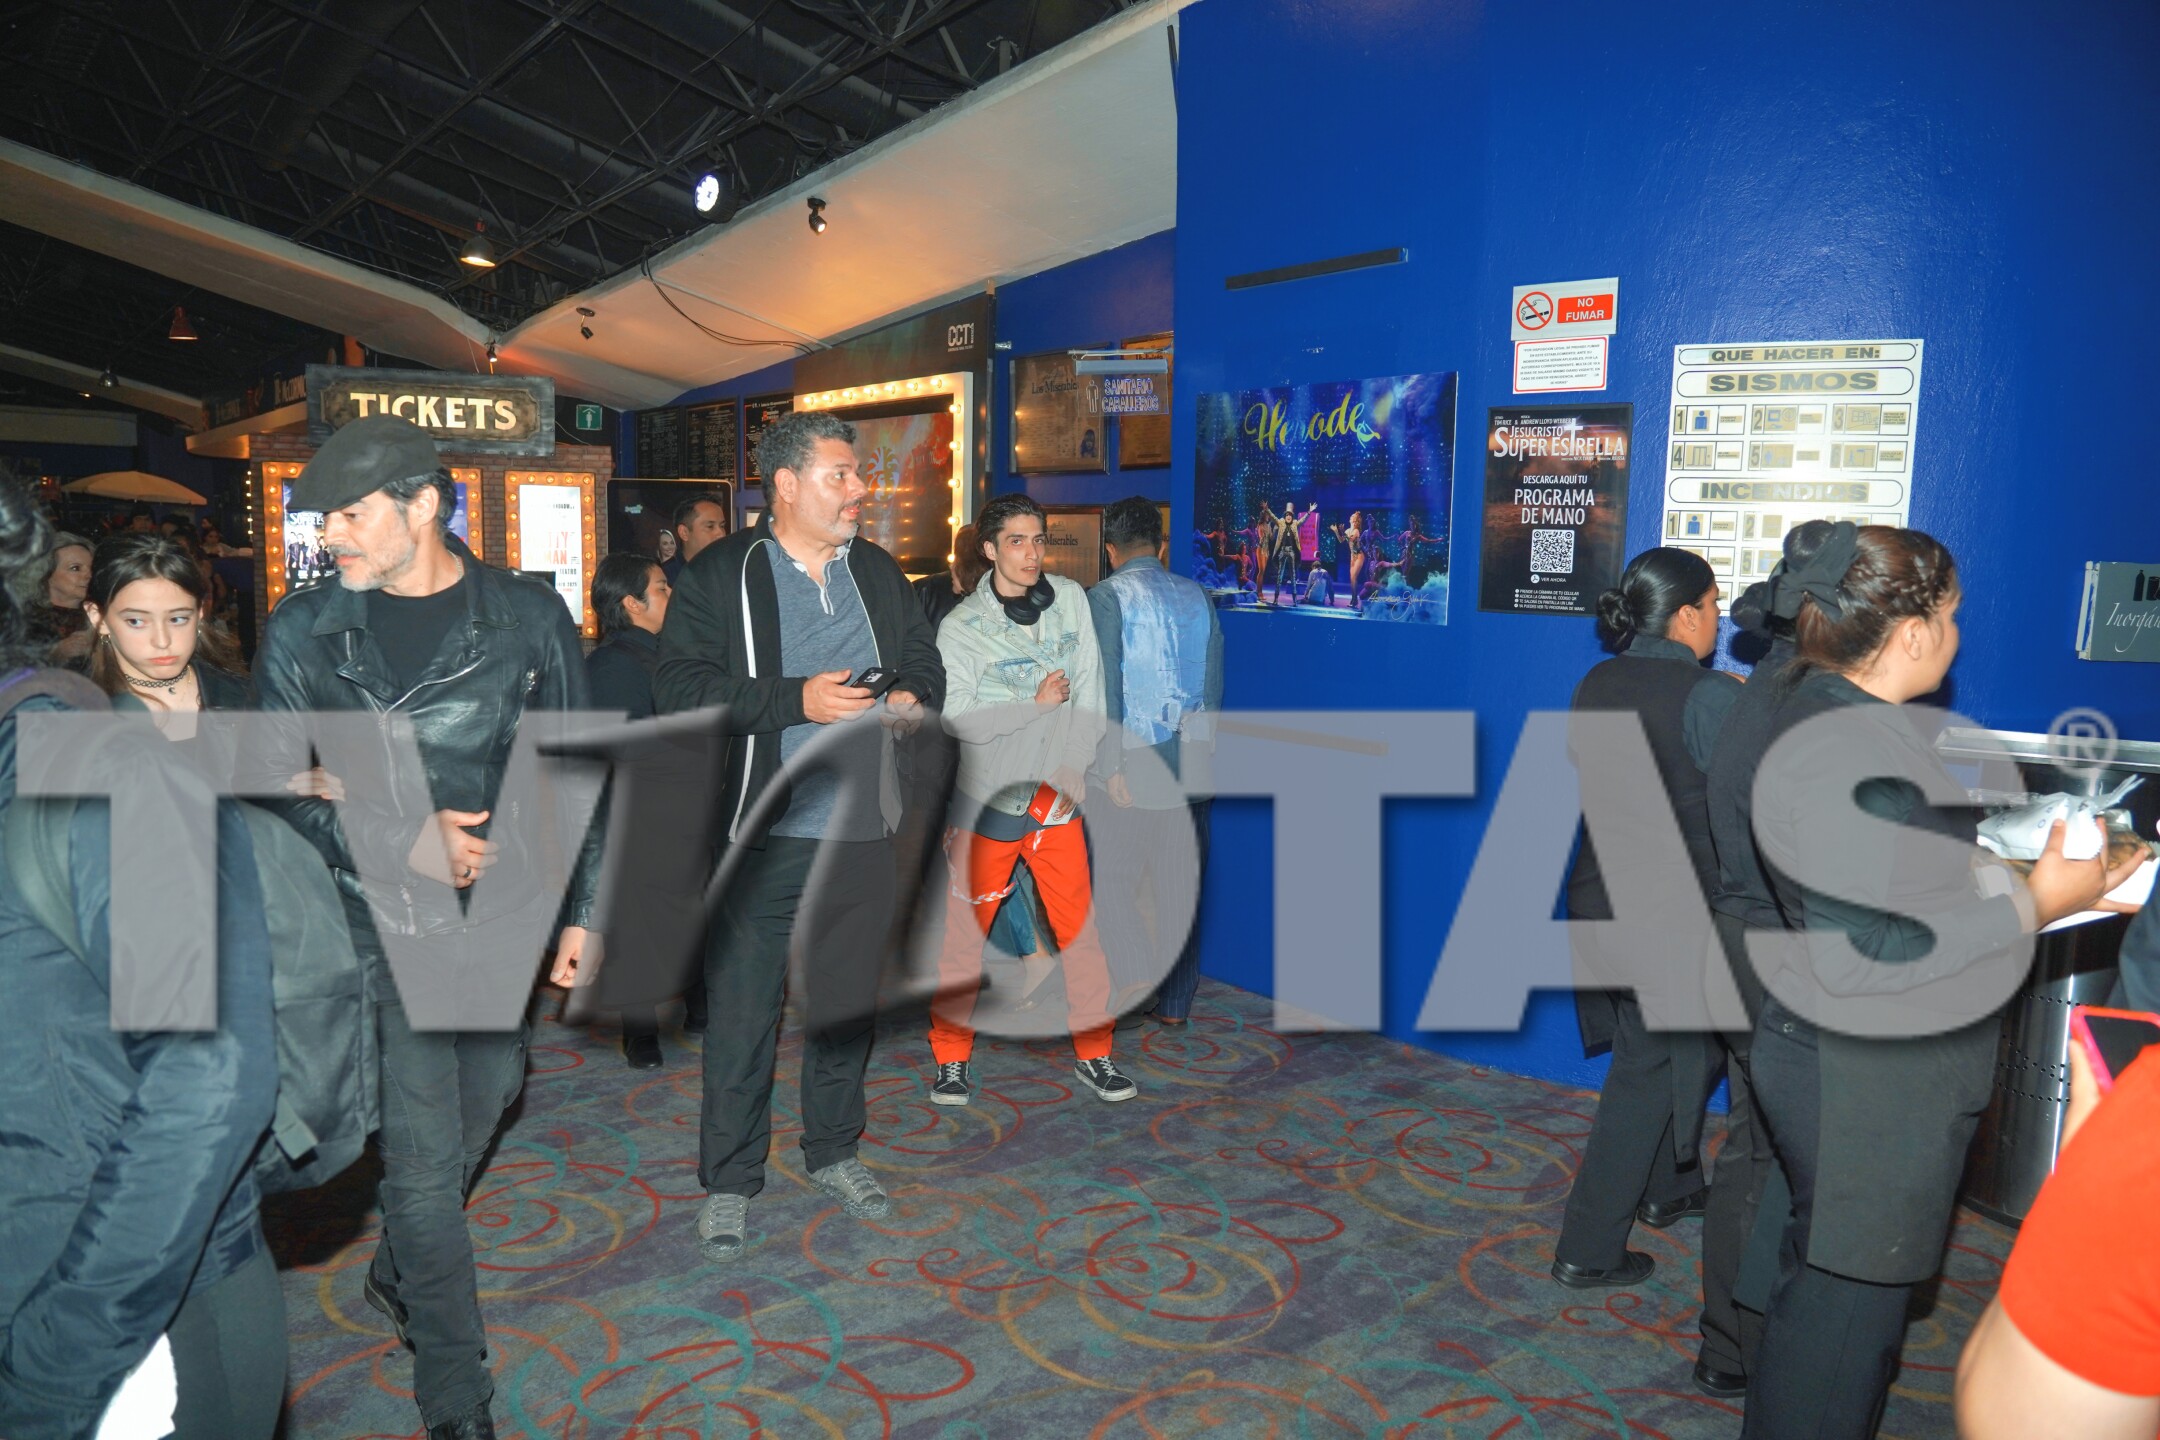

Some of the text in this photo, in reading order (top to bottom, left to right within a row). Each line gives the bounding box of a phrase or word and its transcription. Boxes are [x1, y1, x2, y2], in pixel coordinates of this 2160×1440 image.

[1577, 297, 1594, 308] NO
[1565, 309, 1604, 321] FUMAR
[1711, 347, 1880, 362] QUE HACER EN:
[1104, 378, 1154, 396] SANITARIO
[1709, 372, 1877, 392] SISMOS
[350, 392, 518, 431] TICKETS
[1101, 395, 1159, 413] CABALLEROS
[1677, 410, 1684, 430] 1
[1753, 409, 1763, 430] 2
[1833, 408, 1844, 430] 3
[1509, 425, 1563, 439] JESUCRISTO
[1551, 424, 1625, 456] ESTRELLA
[1673, 445, 1682, 466] 4
[1750, 445, 1760, 466] 5
[1523, 474, 1588, 484] DESCARGA AQUÍ TU
[1514, 488, 1595, 506] PROGRAMA
[1701, 482, 1869, 502] INCENDIOS
[1521, 507, 1585, 525] DE MANO
[1669, 514, 1755, 537] 1 2
